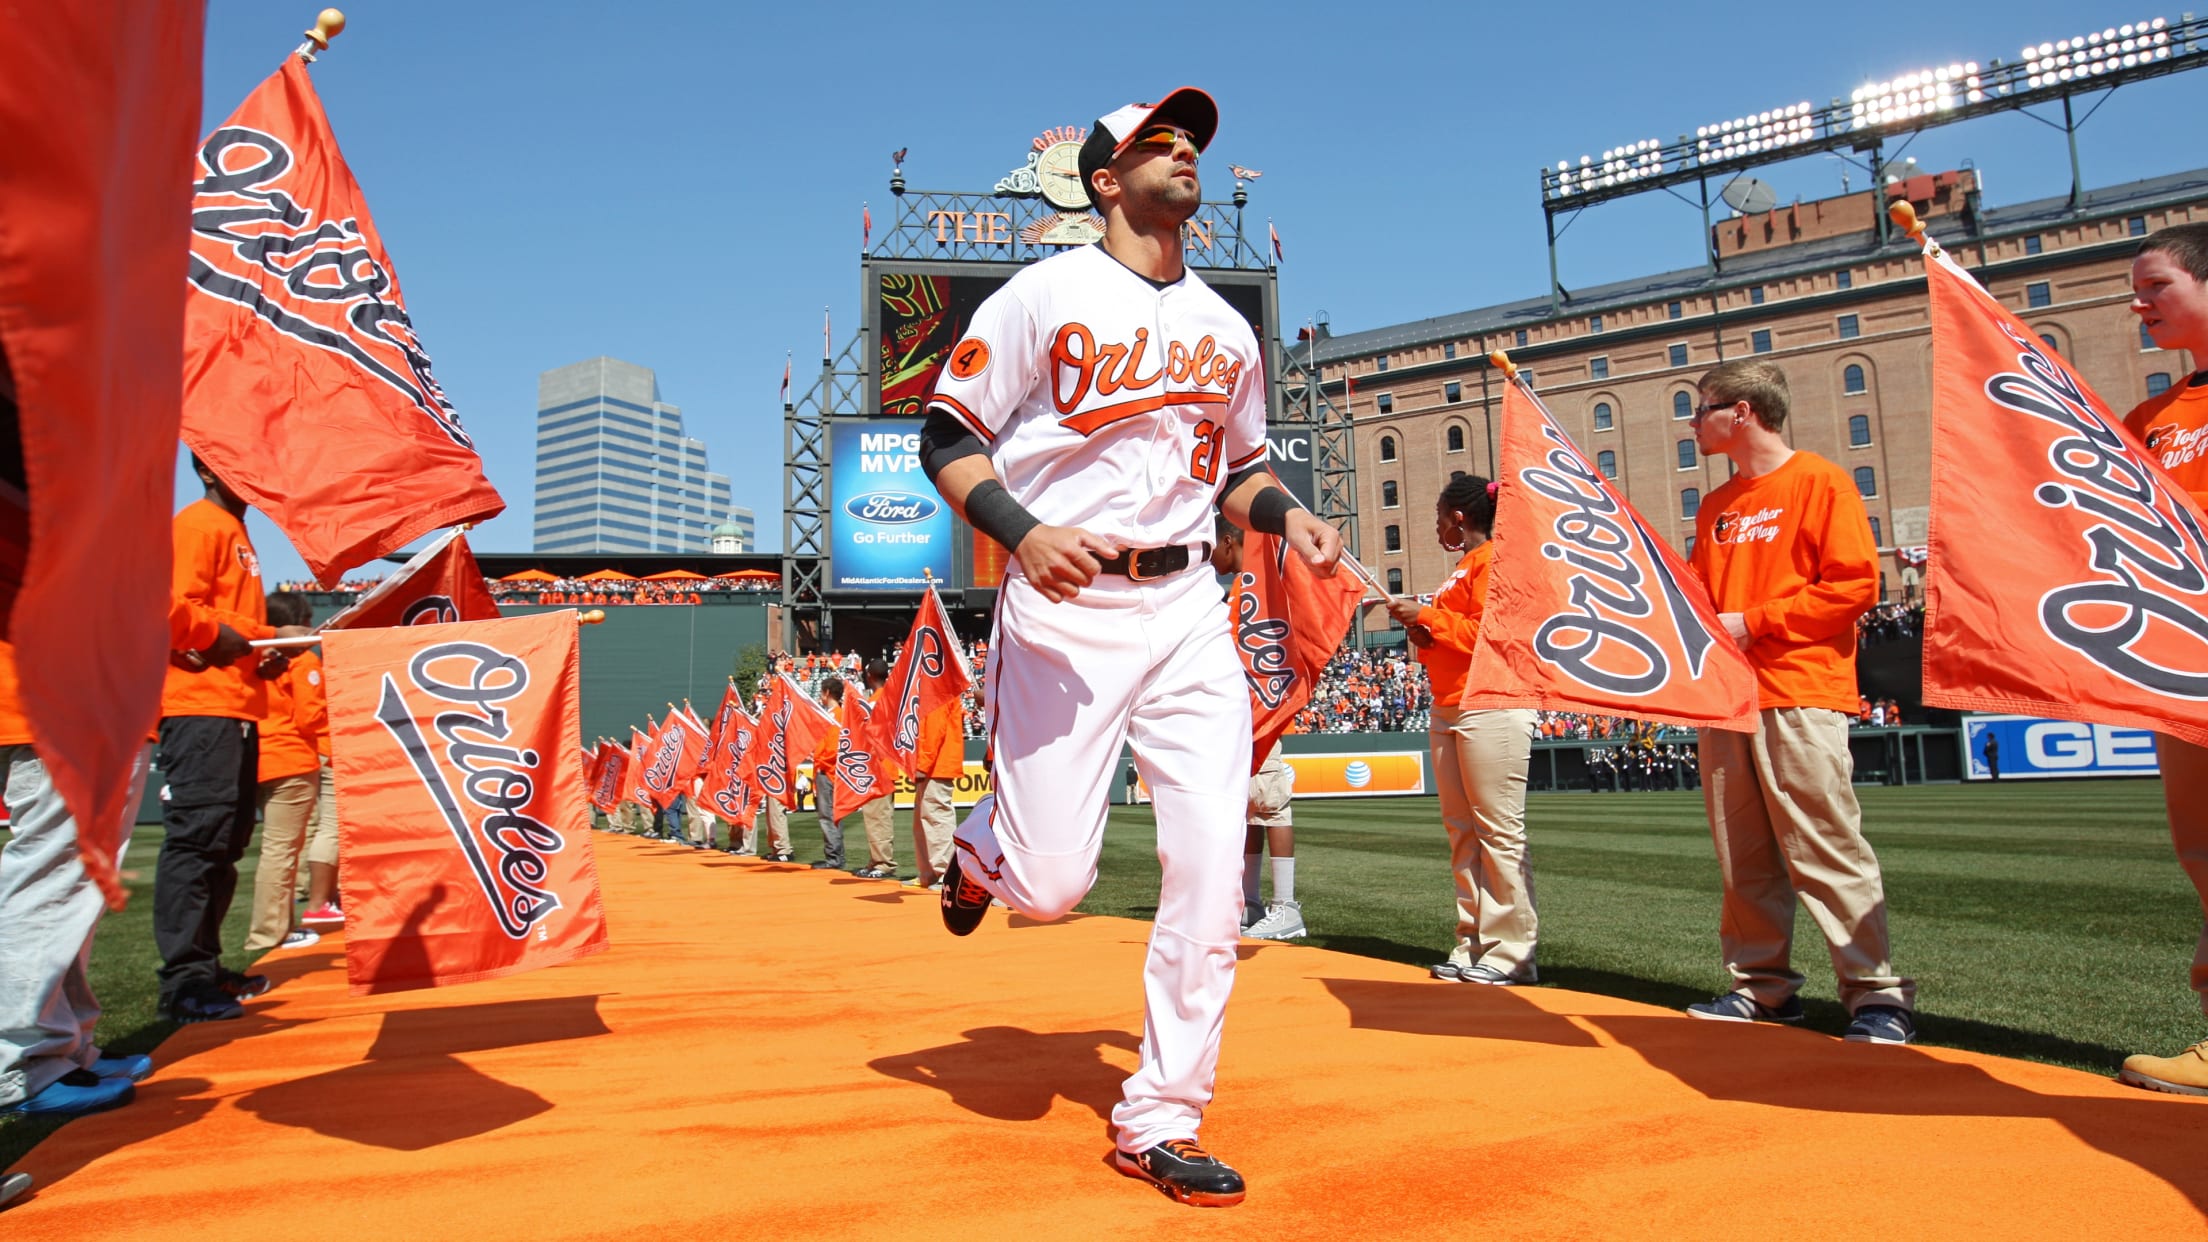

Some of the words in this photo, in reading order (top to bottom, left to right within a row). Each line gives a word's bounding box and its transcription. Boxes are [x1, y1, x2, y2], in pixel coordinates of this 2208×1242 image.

[1032, 125, 1087, 152] ORIOL
[928, 210, 1012, 244] THE
[958, 347, 979, 372] 4
[1050, 322, 1241, 414] Orioles
[860, 433, 921, 452] MPG
[2172, 423, 2208, 449] Toge
[1190, 418, 1226, 486] 21
[1265, 438, 1309, 462] NC
[2161, 446, 2195, 470] We
[860, 455, 921, 473] MVP
[862, 494, 922, 519] Ford
[1737, 507, 1783, 533] gether
[853, 532, 874, 544] Go
[878, 532, 931, 544] Further
[1747, 525, 1779, 543] Play
[2024, 721, 2158, 769] GE
[408, 641, 566, 938] Orioles
